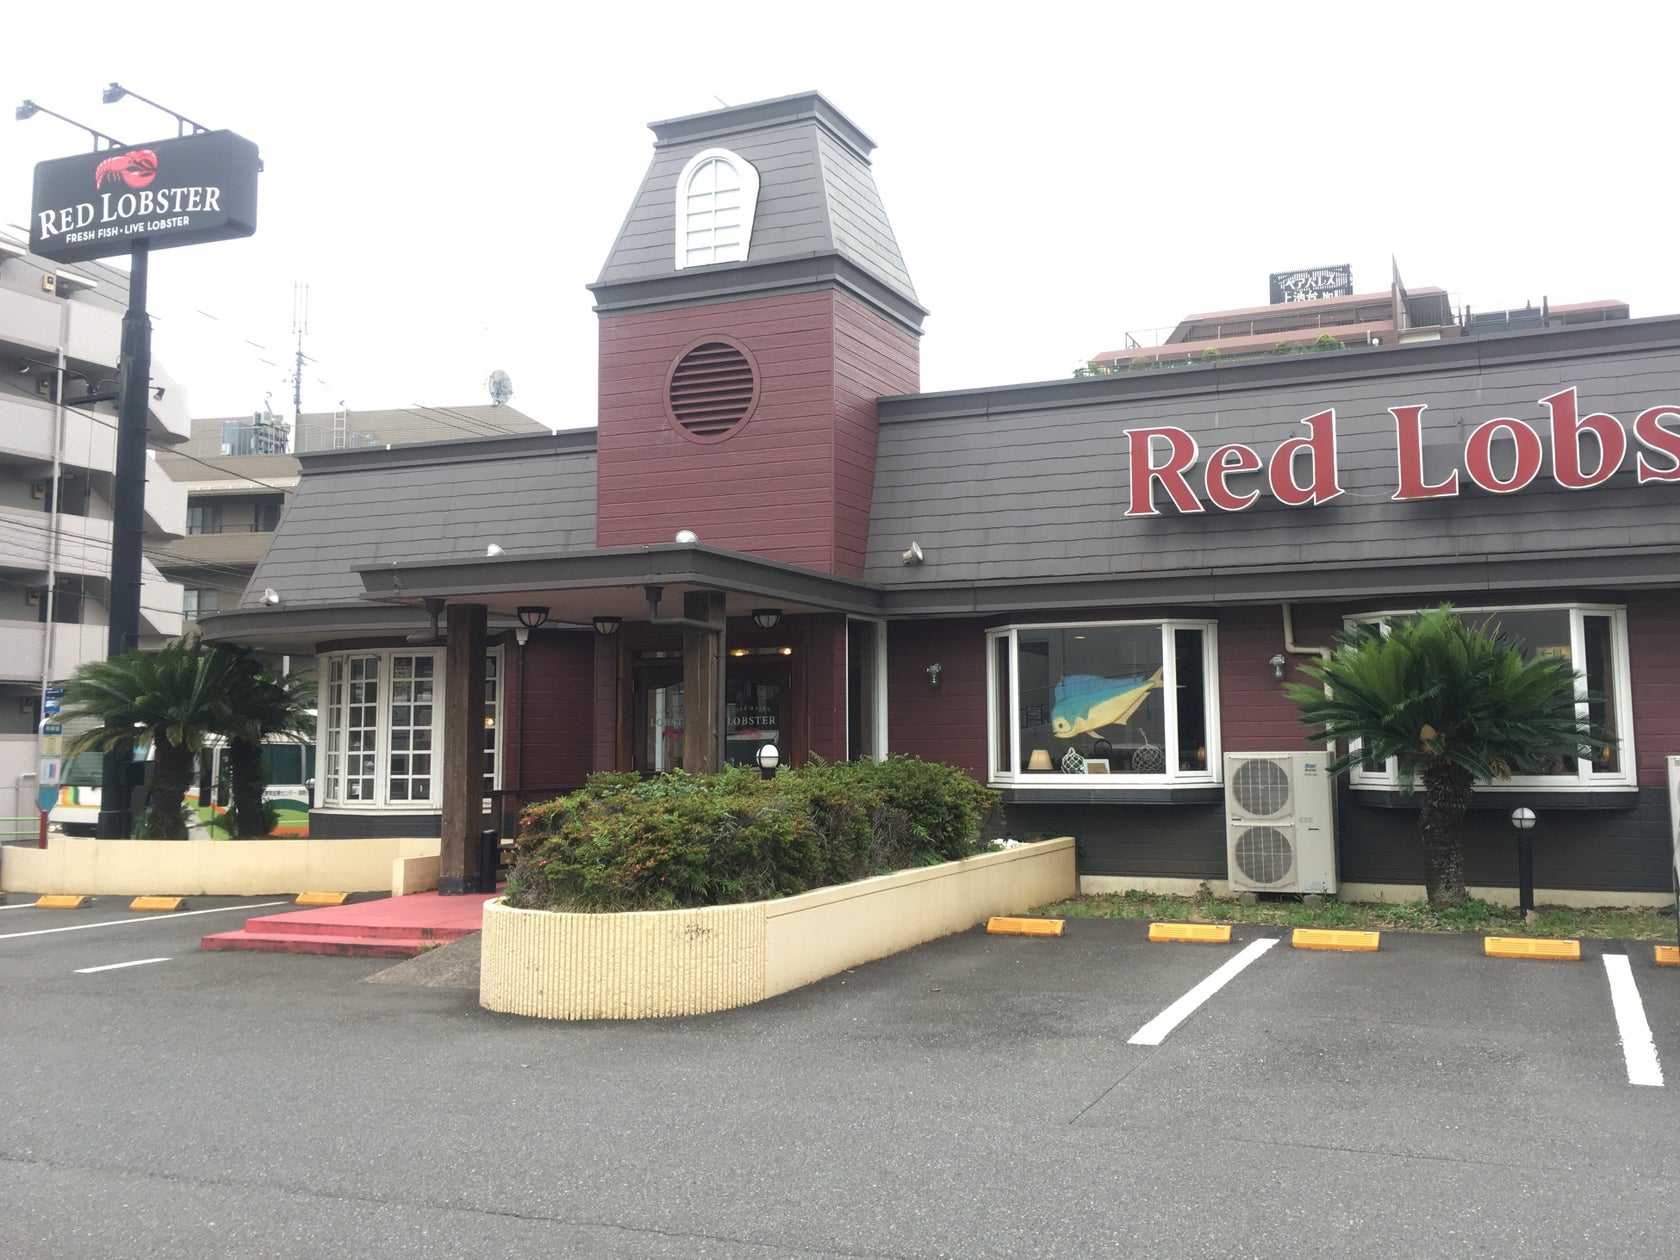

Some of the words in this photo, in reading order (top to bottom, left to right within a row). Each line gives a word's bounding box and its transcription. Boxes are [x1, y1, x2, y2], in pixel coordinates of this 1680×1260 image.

[39, 203, 93, 239] RED
[101, 187, 220, 222] LOBSTER
[66, 228, 95, 243] FRESH
[98, 226, 119, 237] FISH
[125, 222, 144, 234] LIVE
[147, 216, 189, 231] LOBSTER
[1124, 408, 1345, 516] Red
[1388, 386, 1680, 500] Lobs
[727, 715, 776, 726] LOBSTER
